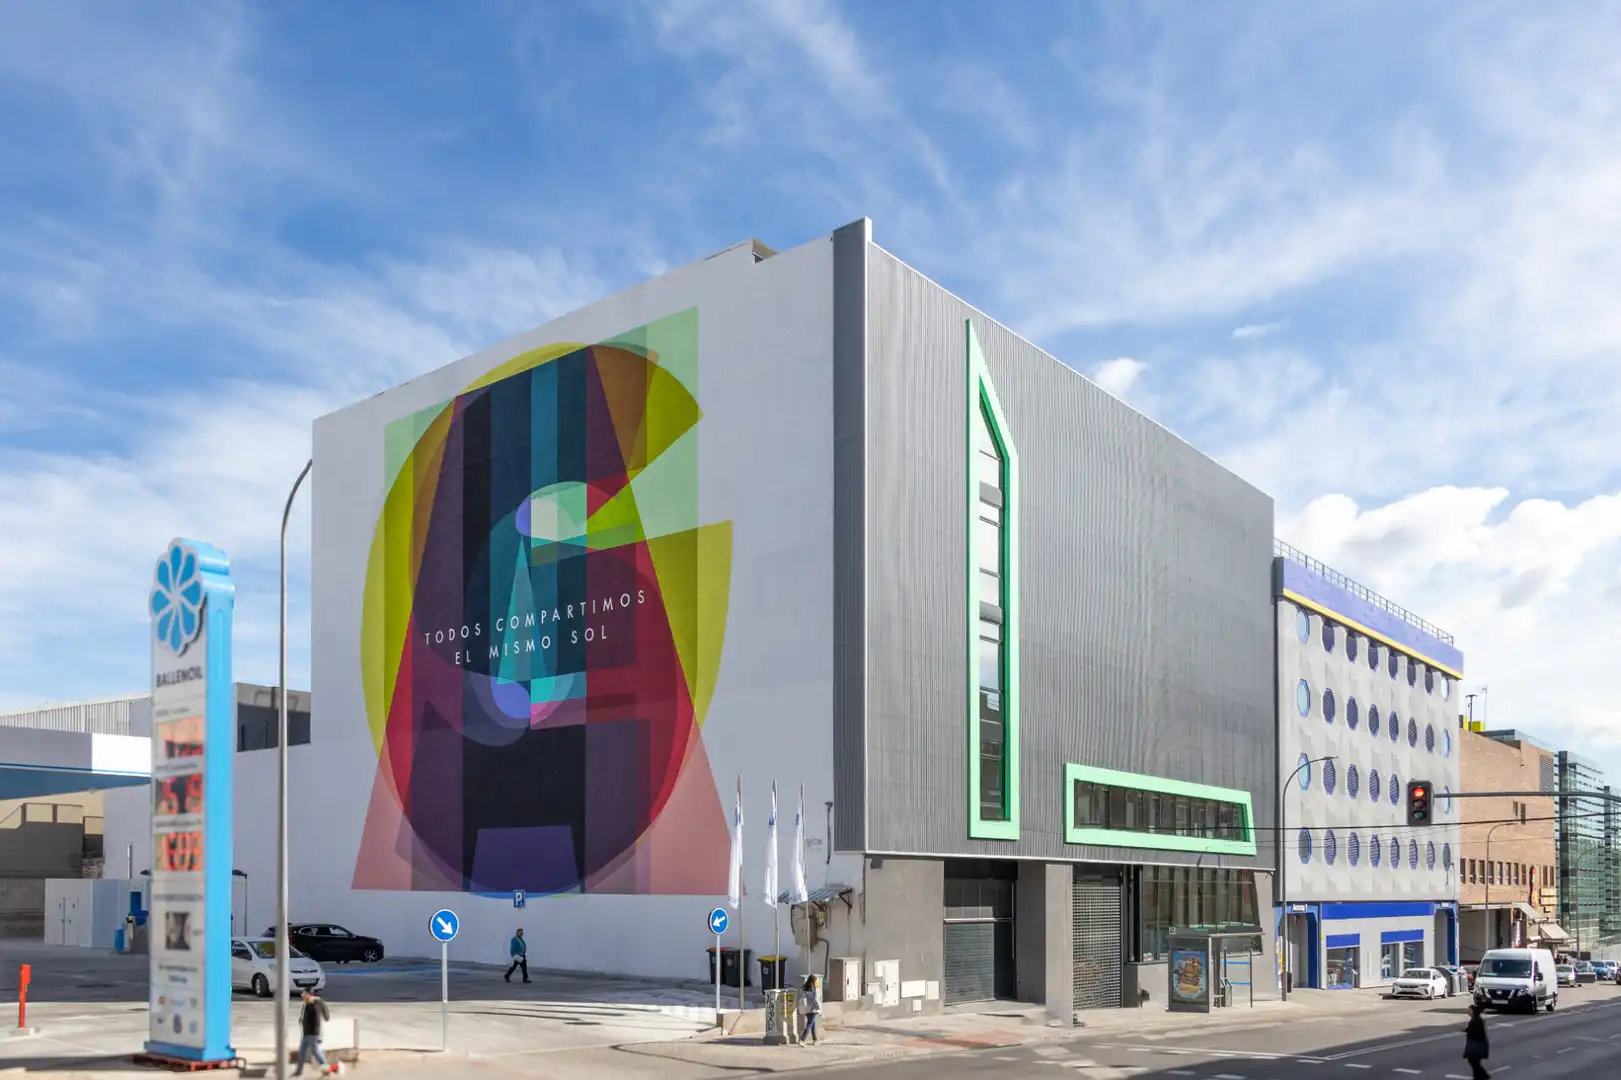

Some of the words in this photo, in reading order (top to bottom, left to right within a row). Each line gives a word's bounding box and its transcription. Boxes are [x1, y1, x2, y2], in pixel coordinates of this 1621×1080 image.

[425, 623, 482, 645] TODOS
[495, 589, 645, 632] COMPARTIMOS
[455, 649, 471, 665] EL
[488, 636, 551, 659] MISMO
[570, 625, 607, 644] SOL
[515, 892, 523, 906] P
